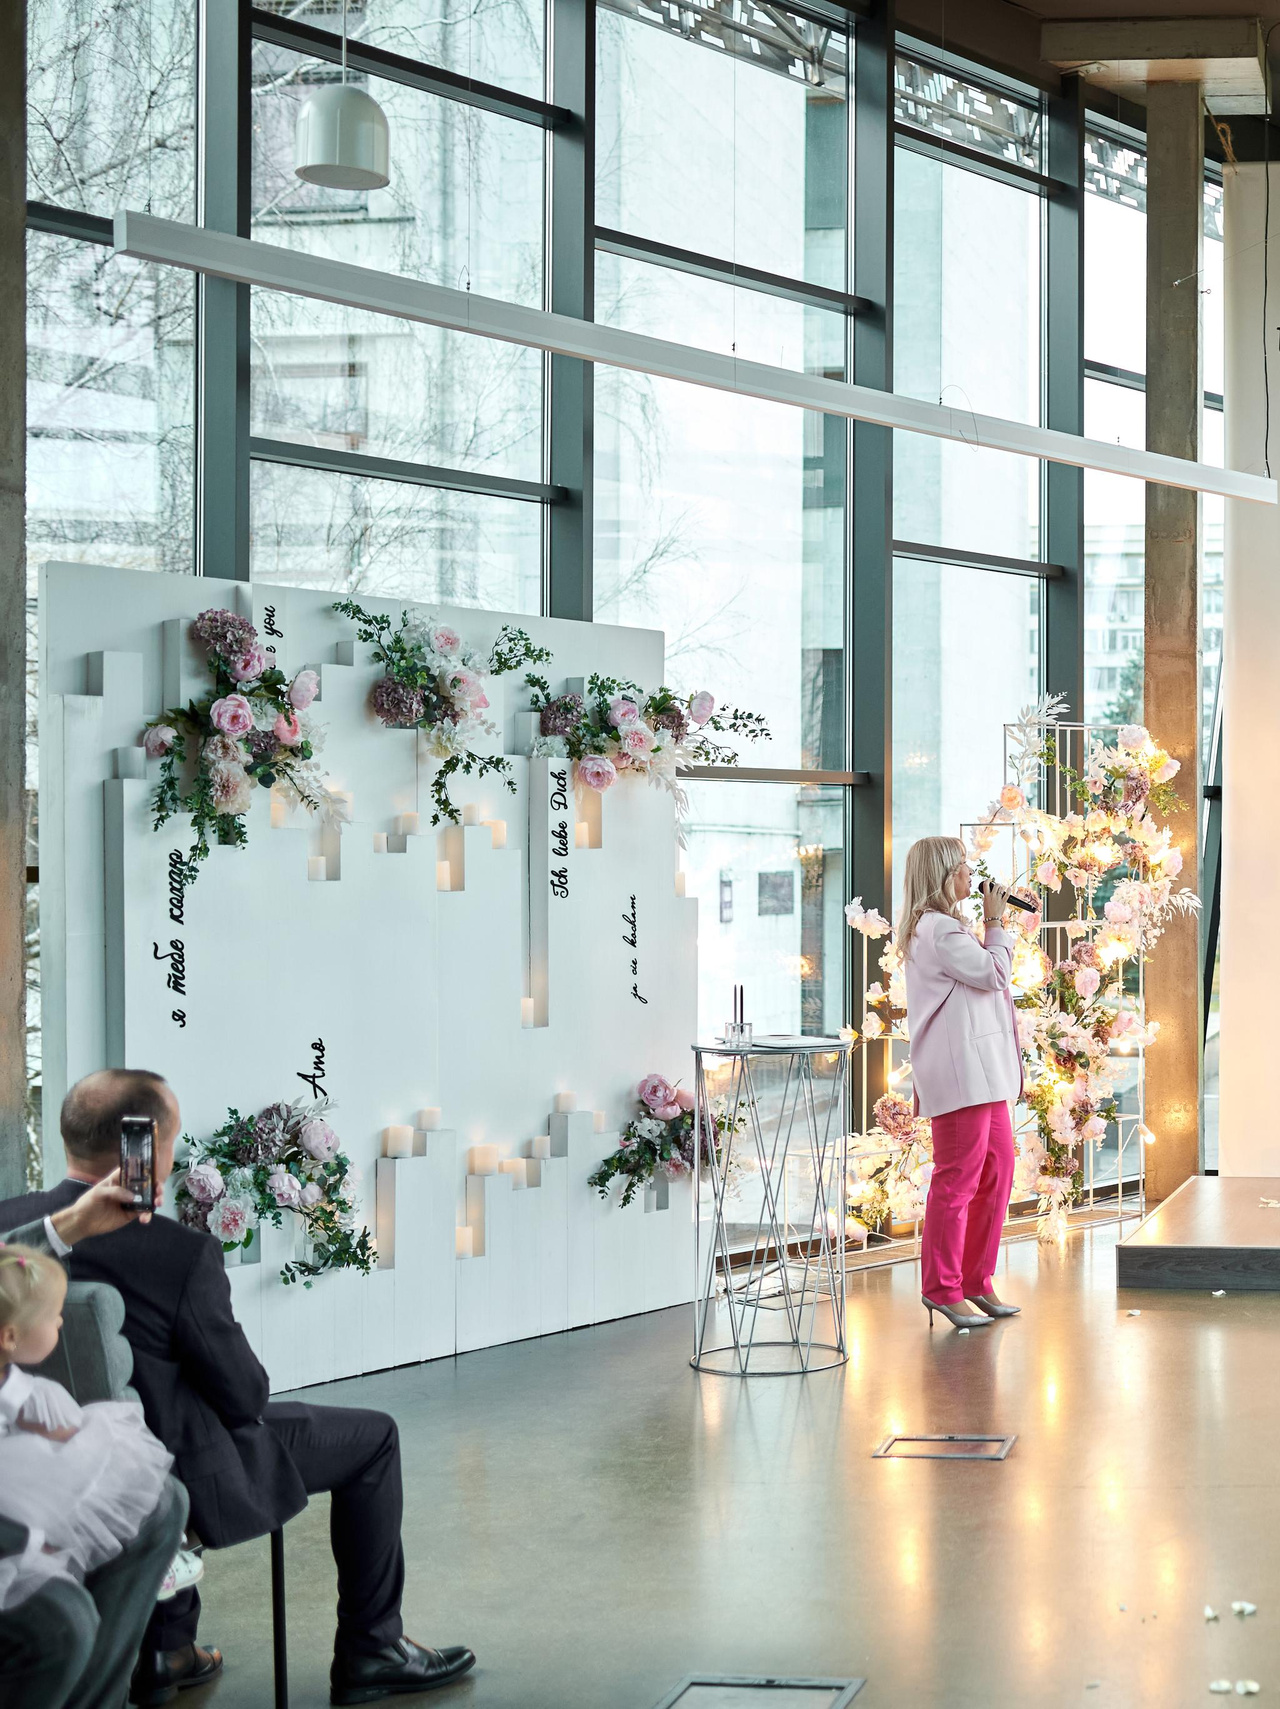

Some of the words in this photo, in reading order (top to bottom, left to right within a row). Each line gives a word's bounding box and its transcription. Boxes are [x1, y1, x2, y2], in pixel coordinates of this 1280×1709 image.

[264, 605, 283, 638] you
[550, 768, 568, 811] Dich
[551, 820, 569, 857] liebe
[550, 867, 569, 899] Ich
[621, 894, 638, 948] kocham
[153, 938, 187, 996] тебе
[631, 983, 648, 1004] ja
[171, 1008, 187, 1029] я
[294, 1037, 329, 1105] Amo
